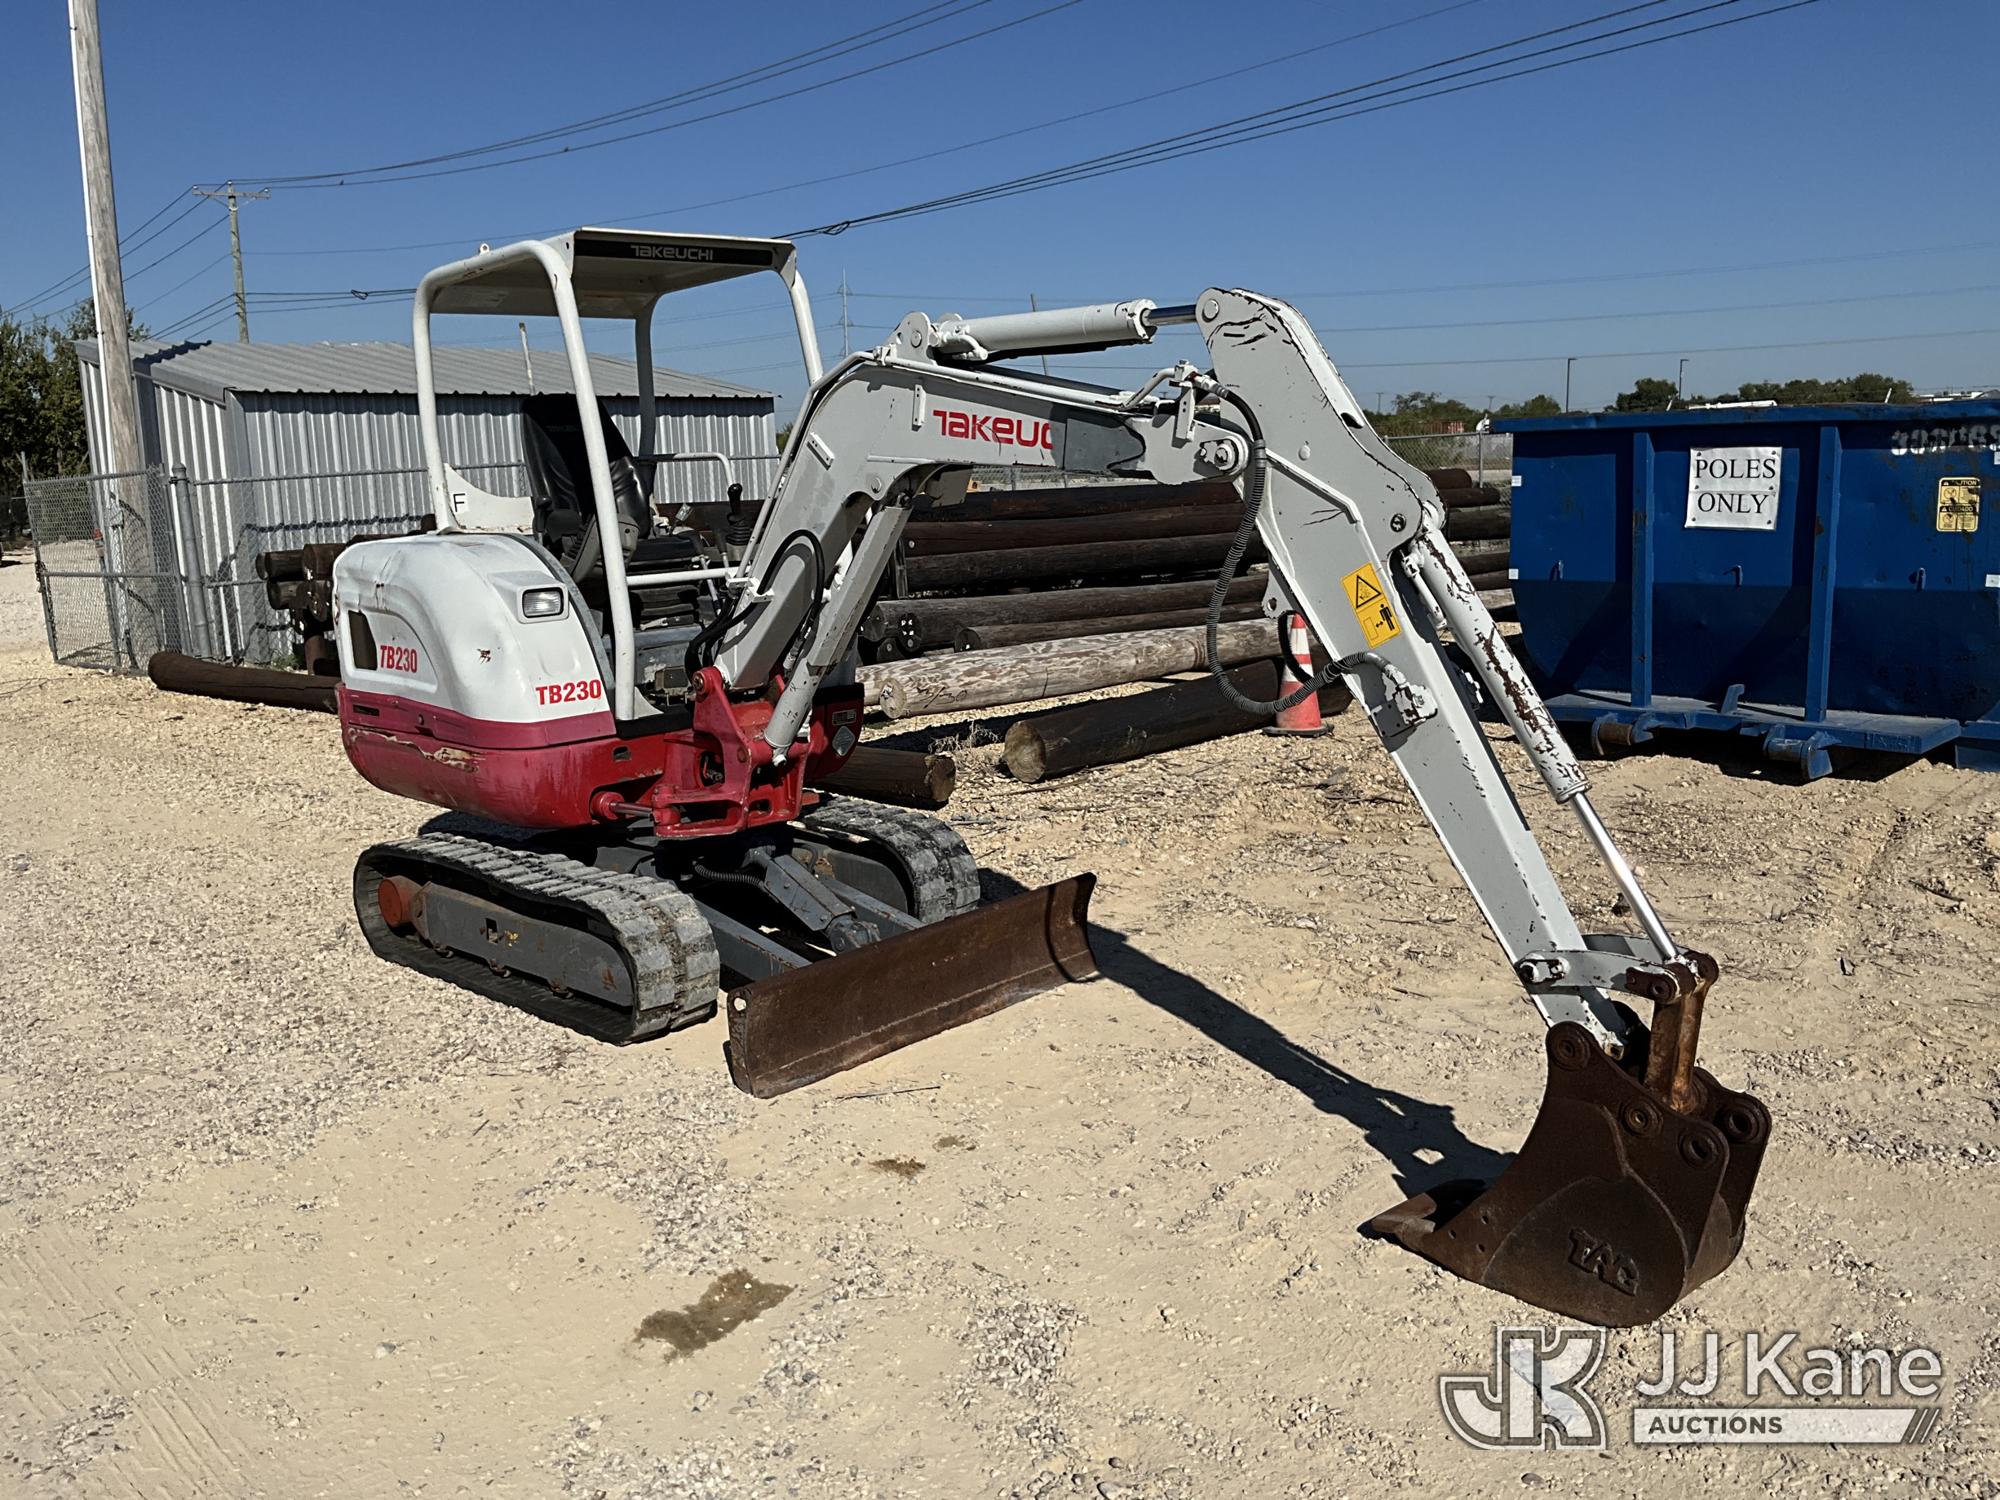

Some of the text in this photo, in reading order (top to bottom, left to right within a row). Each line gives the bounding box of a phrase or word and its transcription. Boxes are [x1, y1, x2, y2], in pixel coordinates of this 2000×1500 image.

[1695, 457, 1777, 480] POLES
[452, 493, 466, 513] F
[1697, 491, 1770, 514] ONLY
[380, 645, 418, 674] TB230
[535, 679, 602, 705] TB230
